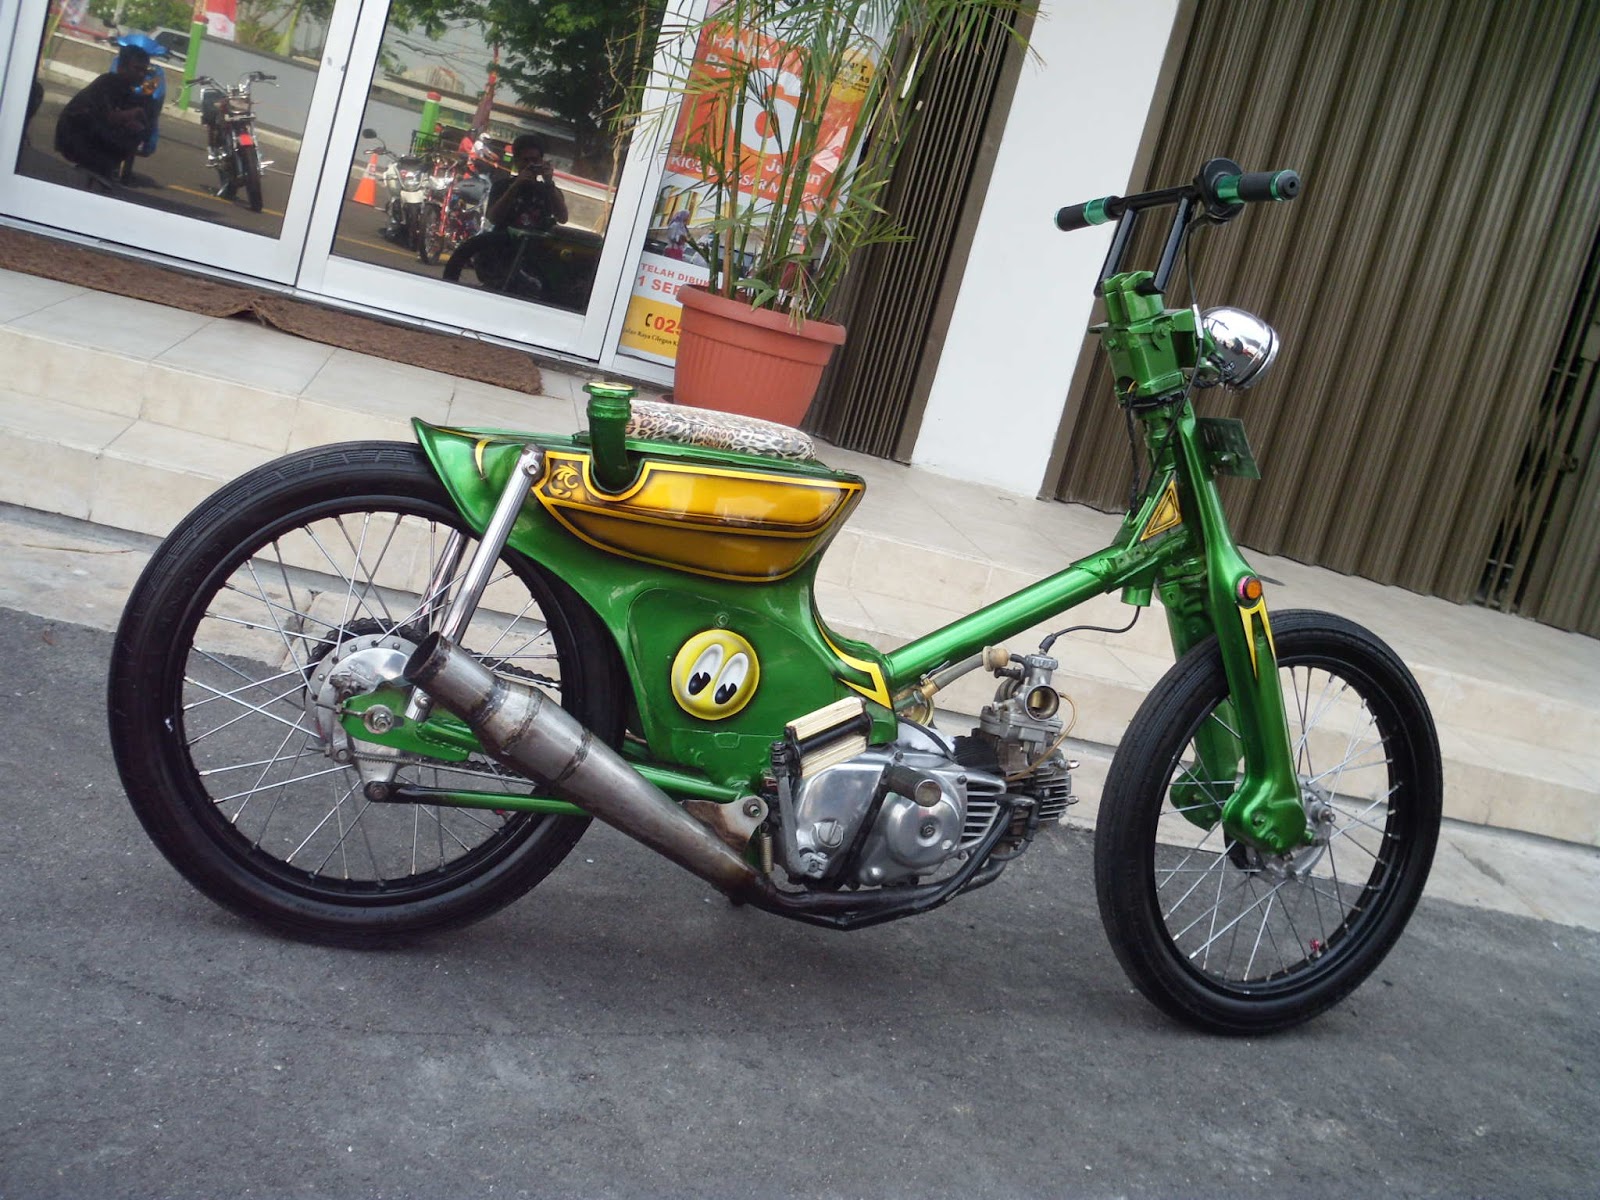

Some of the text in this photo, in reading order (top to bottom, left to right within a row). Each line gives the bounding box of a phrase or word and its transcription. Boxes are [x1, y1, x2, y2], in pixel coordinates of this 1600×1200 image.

[731, 67, 806, 154] 6
[641, 263, 675, 278] TELAH
[638, 275, 646, 287] 1
